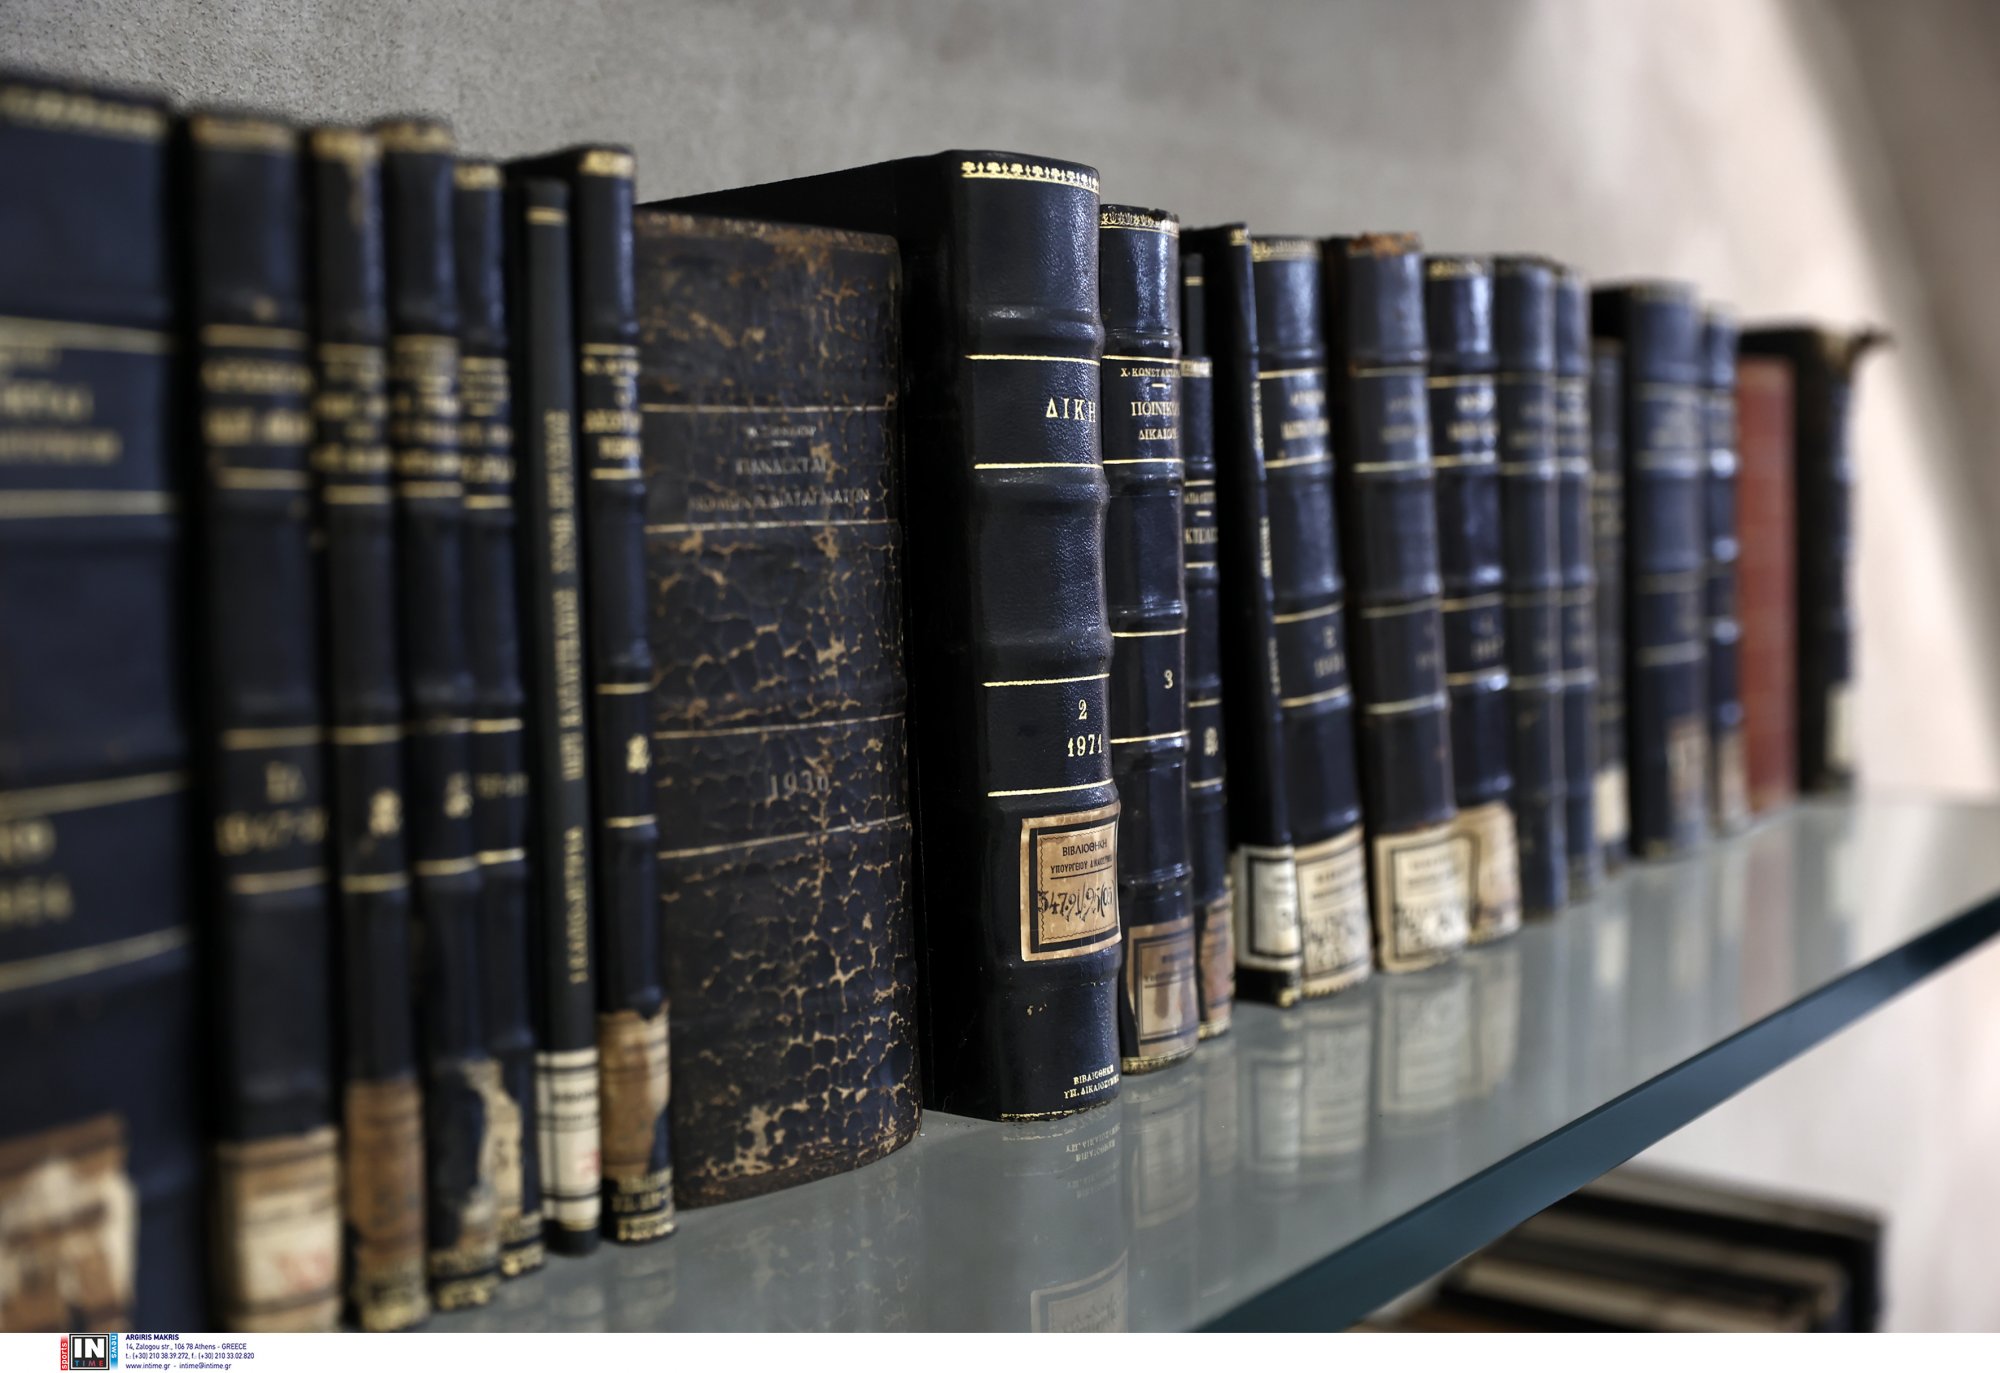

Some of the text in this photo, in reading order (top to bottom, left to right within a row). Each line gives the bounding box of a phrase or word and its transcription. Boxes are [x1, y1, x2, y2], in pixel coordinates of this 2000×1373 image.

[1045, 397, 1096, 423] ΔΙΚΗ
[1164, 669, 1173, 689] 3
[1078, 699, 1088, 720] 2
[1067, 733, 1103, 757] 1971
